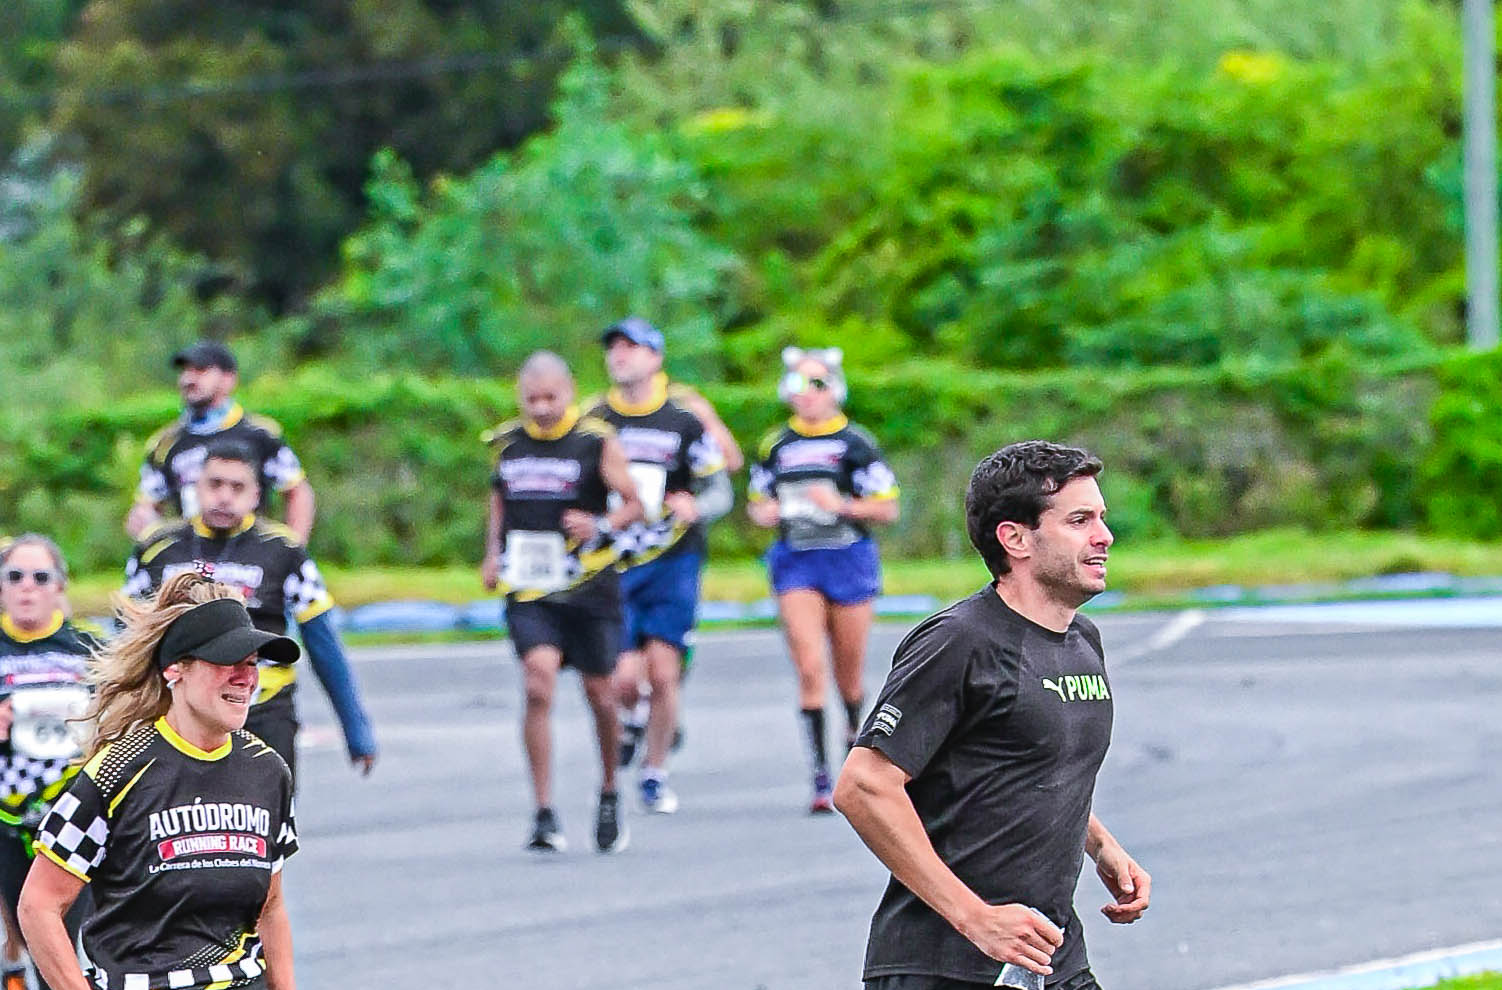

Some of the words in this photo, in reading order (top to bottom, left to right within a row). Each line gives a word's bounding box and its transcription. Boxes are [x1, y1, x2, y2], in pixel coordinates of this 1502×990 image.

[1064, 674, 1111, 701] PUMA
[148, 796, 271, 842] AUTÓDROMO
[171, 835, 228, 857] RUNNING
[228, 835, 259, 854] RACE
